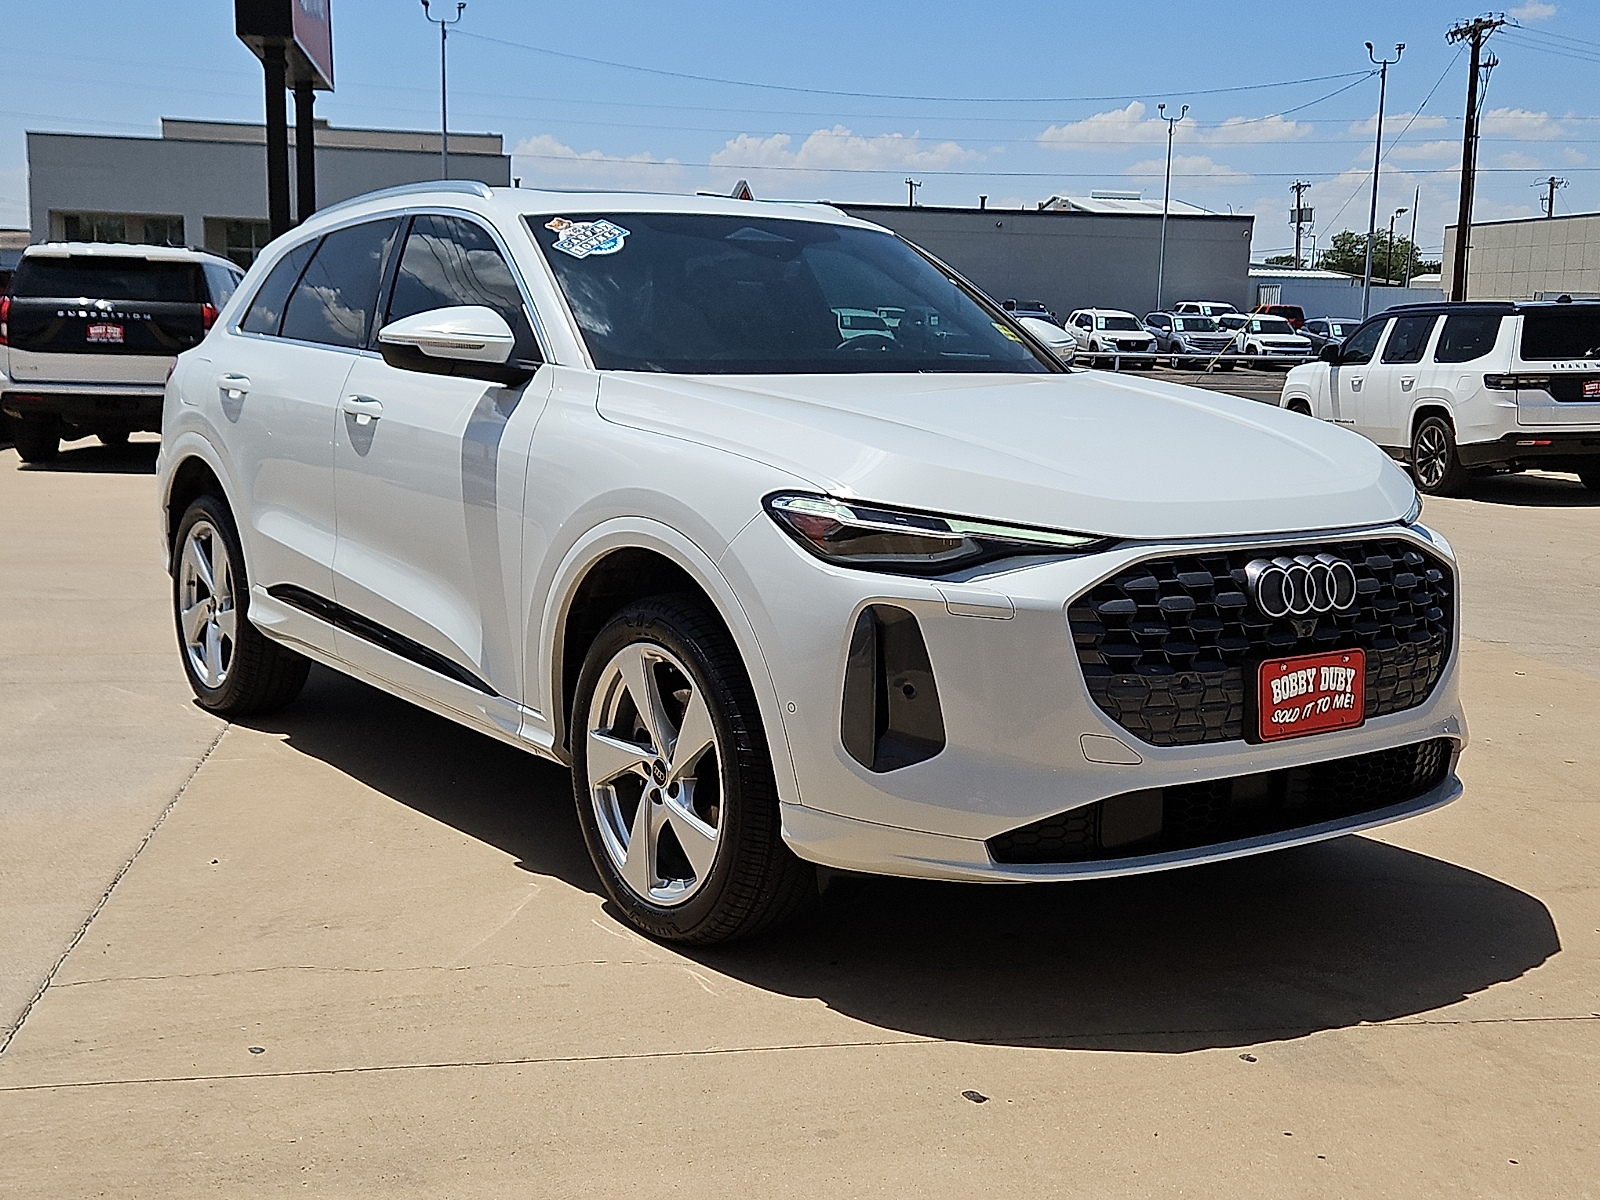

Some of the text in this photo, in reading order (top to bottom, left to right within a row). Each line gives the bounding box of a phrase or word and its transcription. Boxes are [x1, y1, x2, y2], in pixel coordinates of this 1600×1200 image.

[1271, 667, 1356, 704] BOBBY DUBY
[1271, 693, 1355, 723] SOLD IT TO ME!
